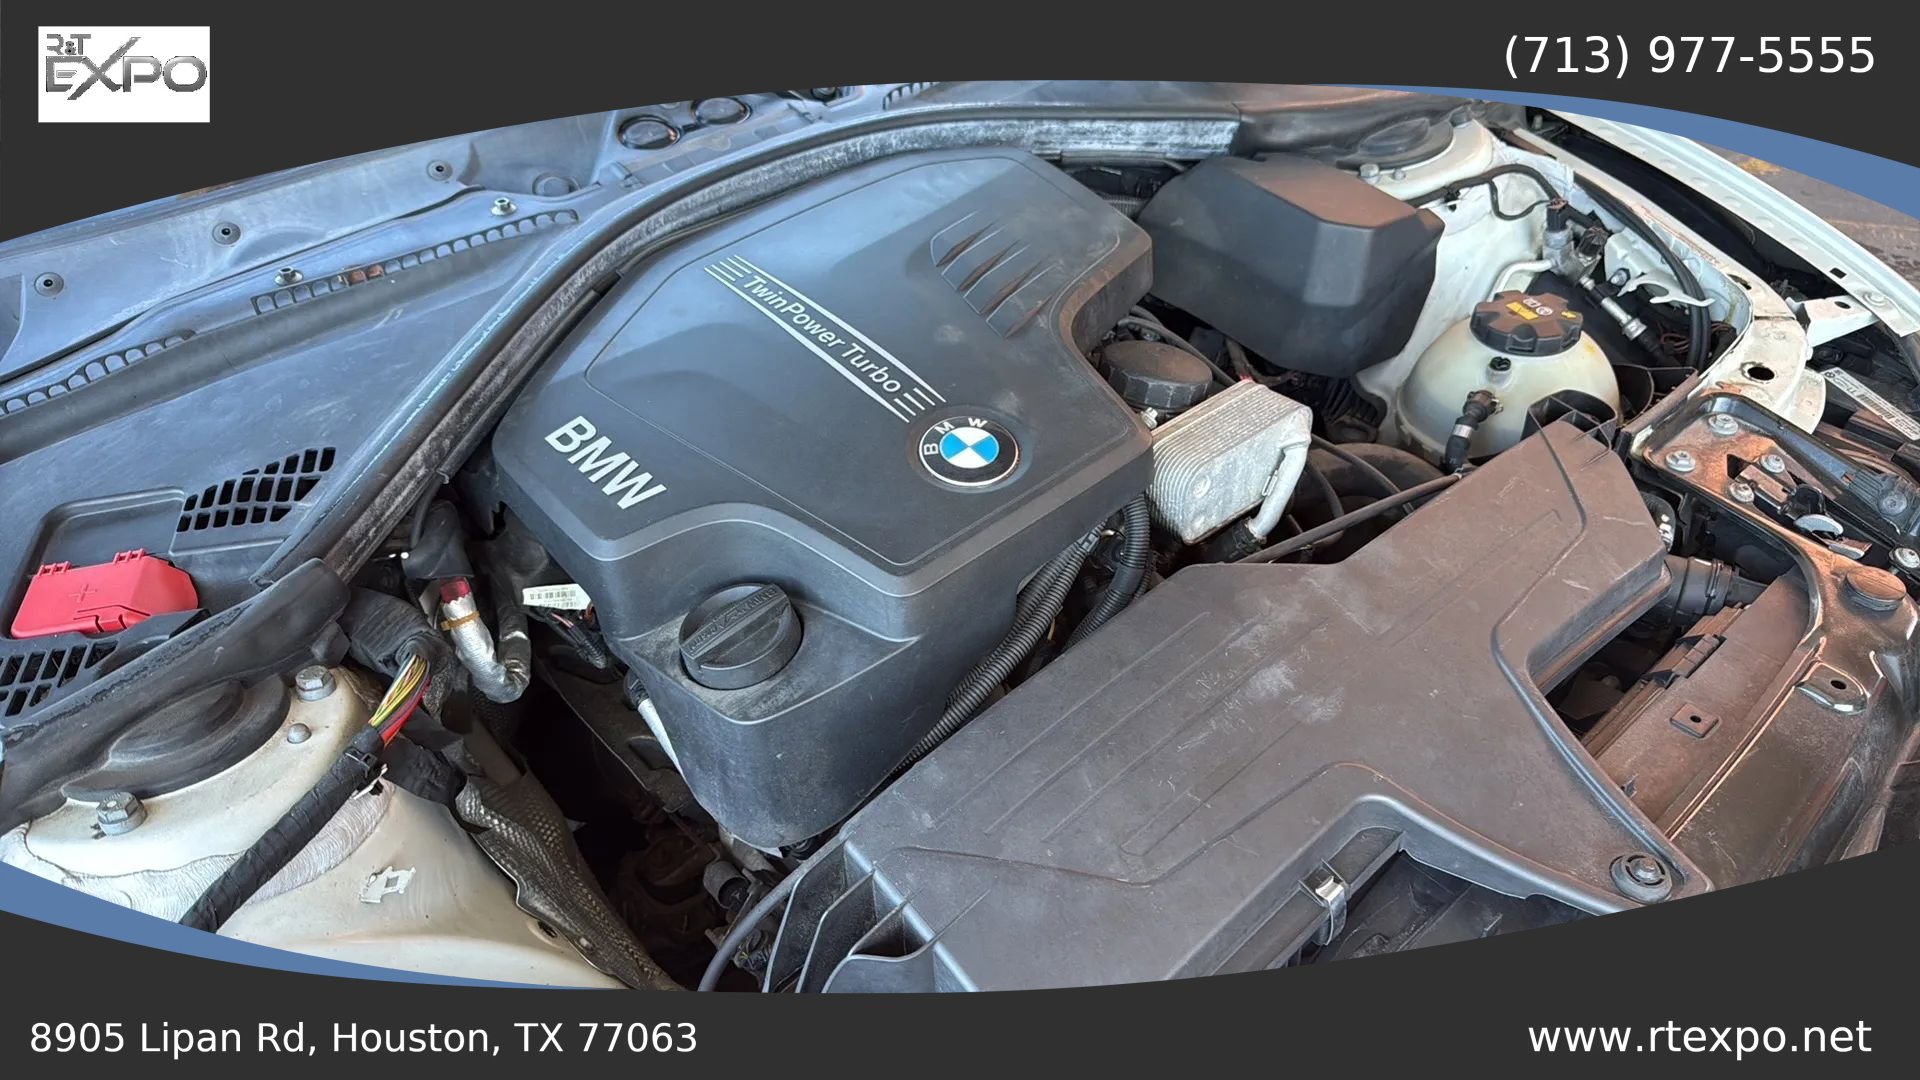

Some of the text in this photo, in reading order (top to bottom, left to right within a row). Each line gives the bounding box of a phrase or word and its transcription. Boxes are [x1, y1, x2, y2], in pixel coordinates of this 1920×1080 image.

[743, 275, 901, 393] TwinPower Turbo
[544, 415, 667, 510] BMW
[923, 416, 988, 456] BMW
